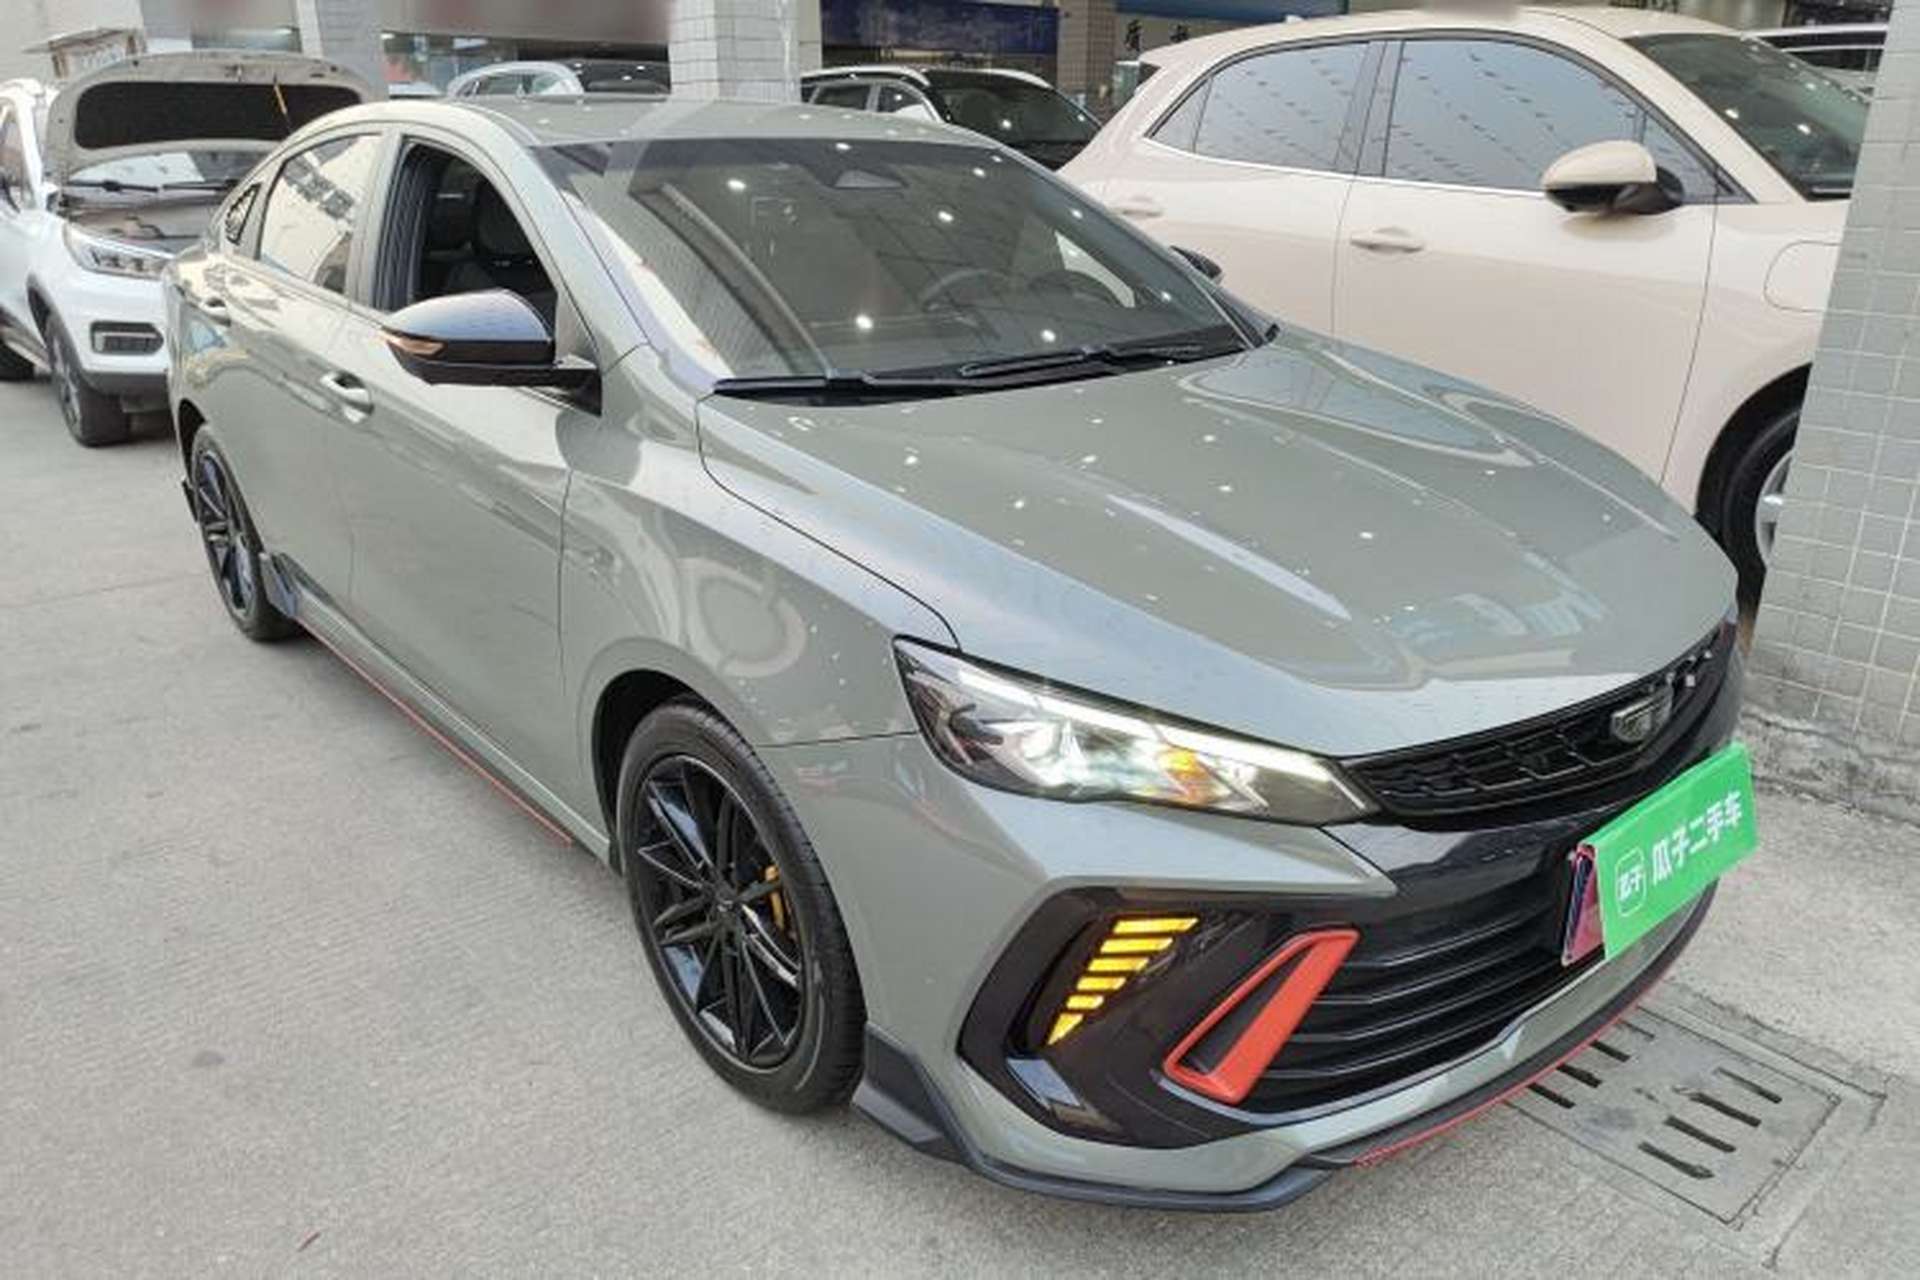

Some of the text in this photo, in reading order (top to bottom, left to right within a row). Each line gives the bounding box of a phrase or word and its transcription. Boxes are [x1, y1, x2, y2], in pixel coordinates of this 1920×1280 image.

[1652, 791, 1742, 886] 瓜子二手车
